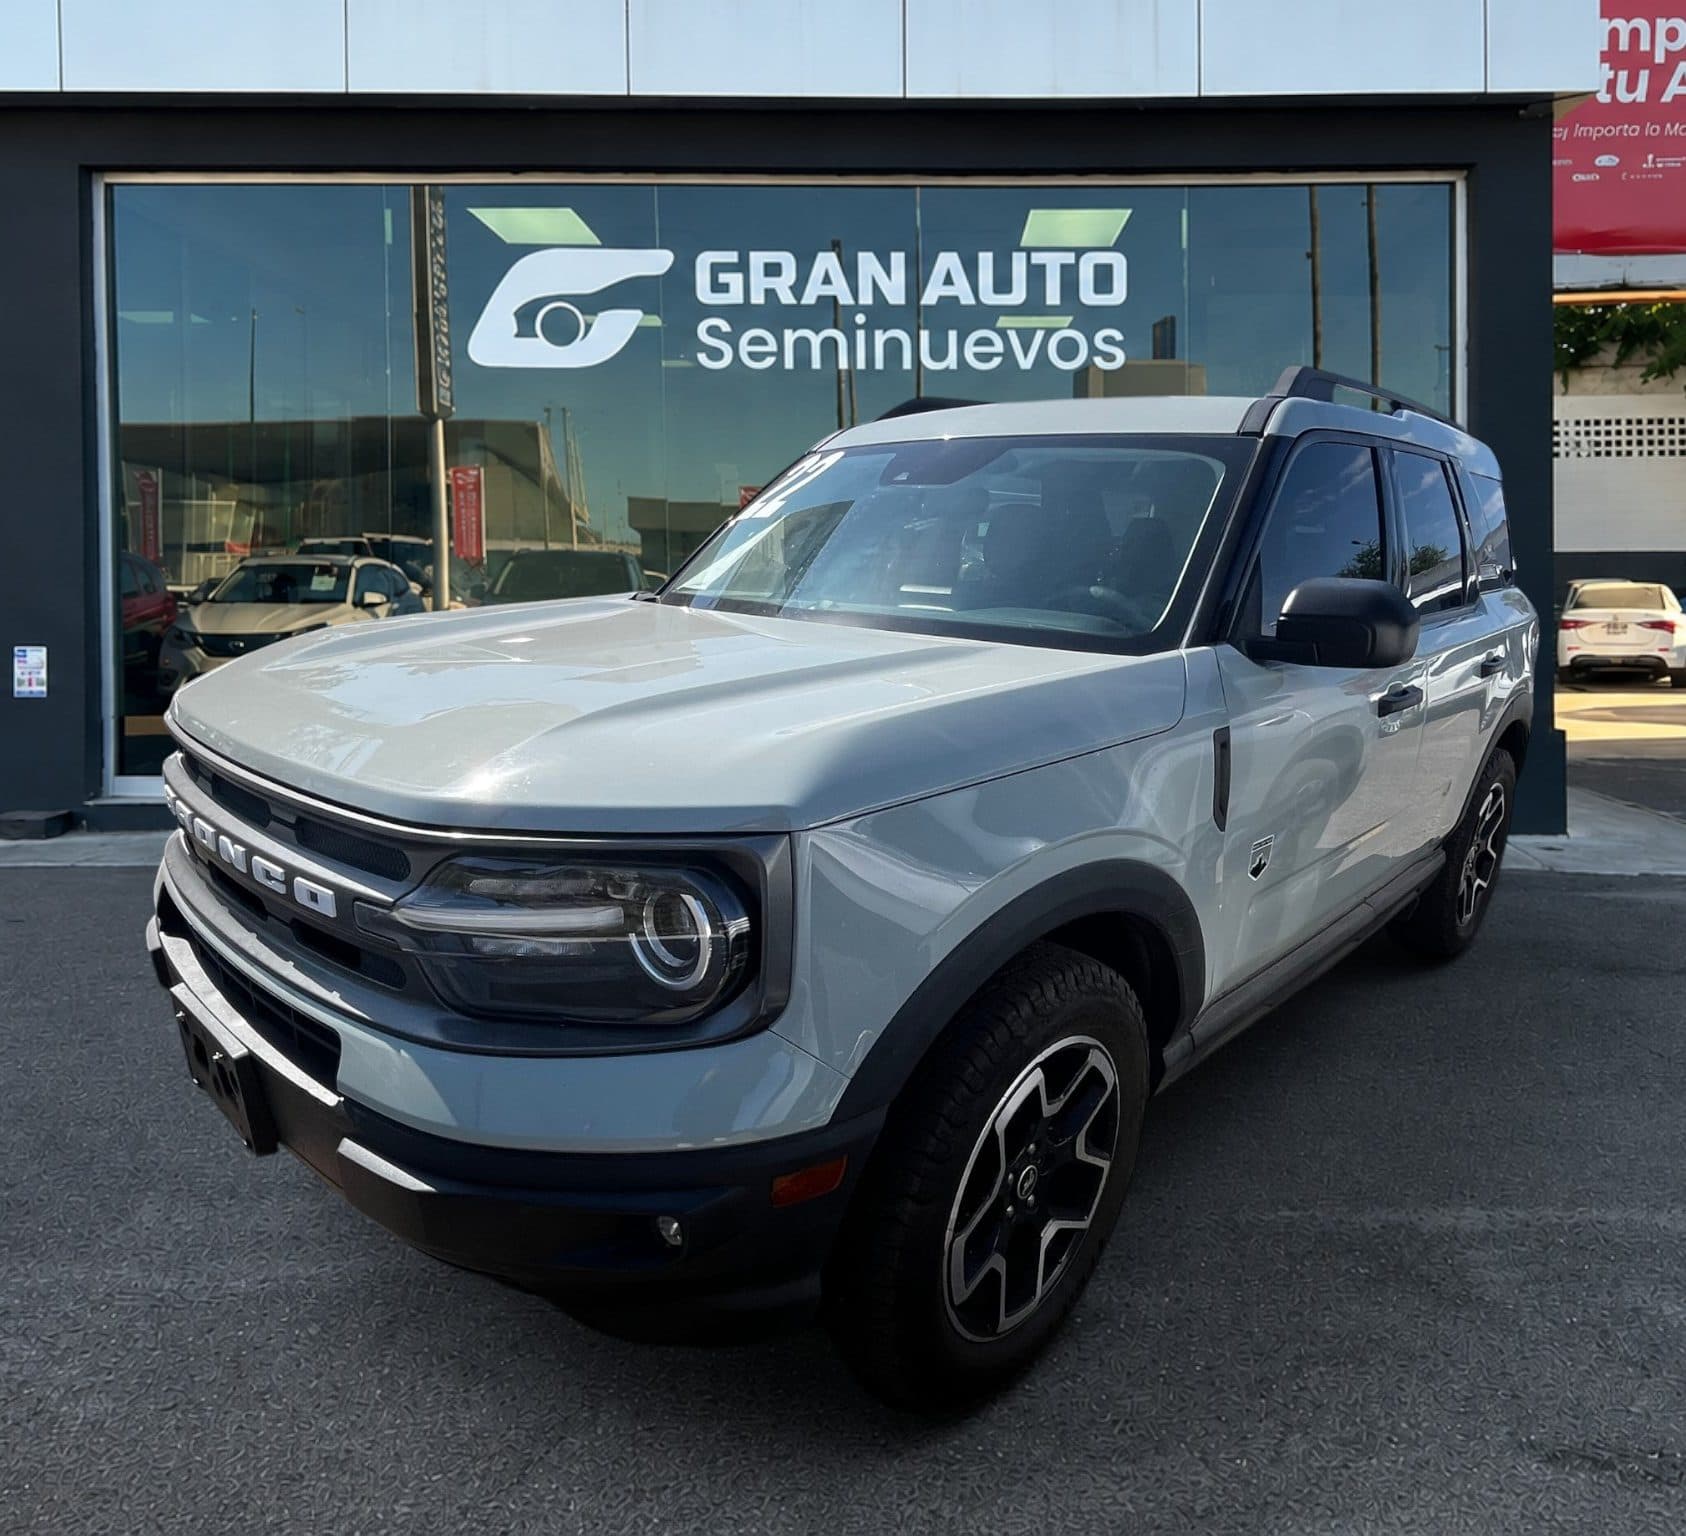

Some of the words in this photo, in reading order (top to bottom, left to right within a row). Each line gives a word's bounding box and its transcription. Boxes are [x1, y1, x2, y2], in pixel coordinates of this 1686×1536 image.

[1596, 62, 1651, 104] tu
[1573, 122, 1641, 142] Importa
[694, 250, 907, 306] GRAN
[920, 250, 1129, 307] AUTO
[696, 312, 1127, 372] Seminuevos
